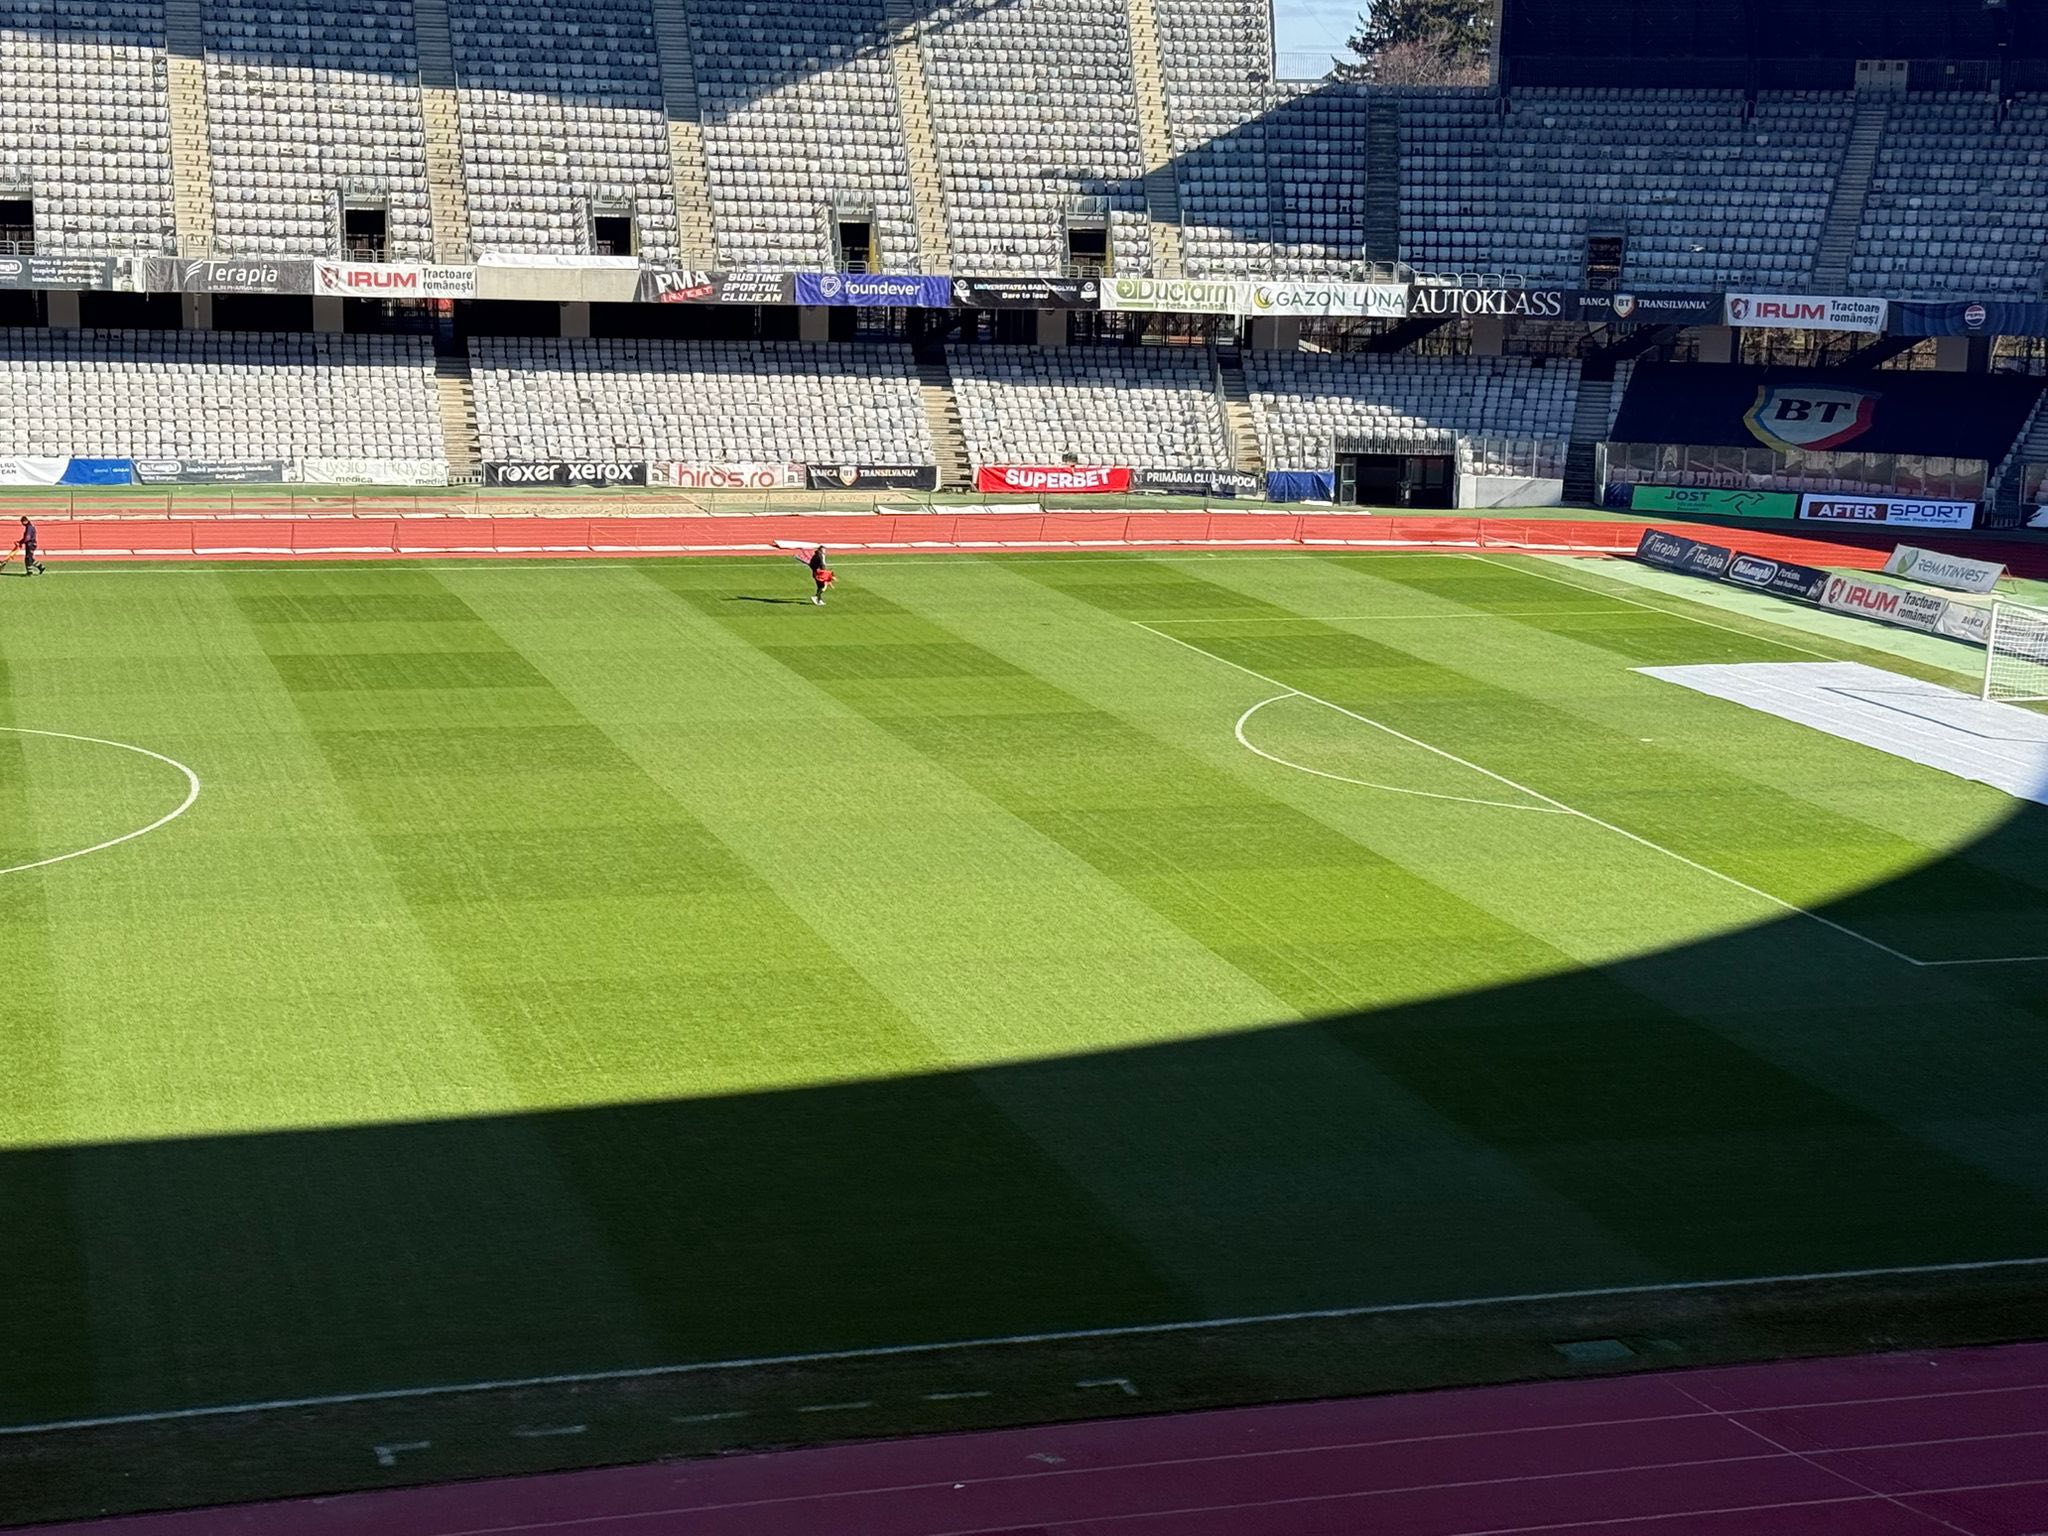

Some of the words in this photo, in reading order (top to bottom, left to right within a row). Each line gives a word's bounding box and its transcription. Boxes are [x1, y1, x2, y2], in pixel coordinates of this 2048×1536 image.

[203, 260, 279, 286] Terapia
[347, 271, 418, 288] IRUM
[422, 267, 473, 280] Tractoare
[655, 270, 711, 294] PMA
[722, 282, 782, 292] SPORTUL
[845, 281, 921, 296] foundever
[721, 293, 783, 302] CLUJEAN
[1276, 291, 1346, 307] GAZON
[1353, 291, 1406, 308] LUNA
[1409, 288, 1562, 316] AUTOKLASS
[1579, 297, 1611, 307] BANCA
[1618, 298, 1631, 308] BT
[1637, 298, 1707, 310] TRANSILVANIA
[1755, 302, 1826, 320] IRUM
[1831, 300, 1881, 313] Tractoare
[1774, 398, 1852, 424] BT
[335, 475, 373, 484] medica
[497, 463, 560, 482] roxer
[567, 463, 634, 481] xerox
[678, 463, 775, 488] hiros.ro
[859, 469, 916, 478] TRANSILVANIA
[1004, 468, 1112, 489] SUPERBET
[1146, 470, 1194, 484] PRIMĂRIA
[1194, 472, 1257, 488] CLUJ-NAPOCA
[1664, 489, 1711, 502] JOST
[1817, 504, 1877, 519] AFTER
[1889, 504, 1969, 518] SPORT
[1651, 533, 1681, 557] Terapia
[1693, 545, 1724, 569] Terapia
[1844, 585, 1901, 614] IRUM
[1902, 591, 1942, 611] Tractoare
